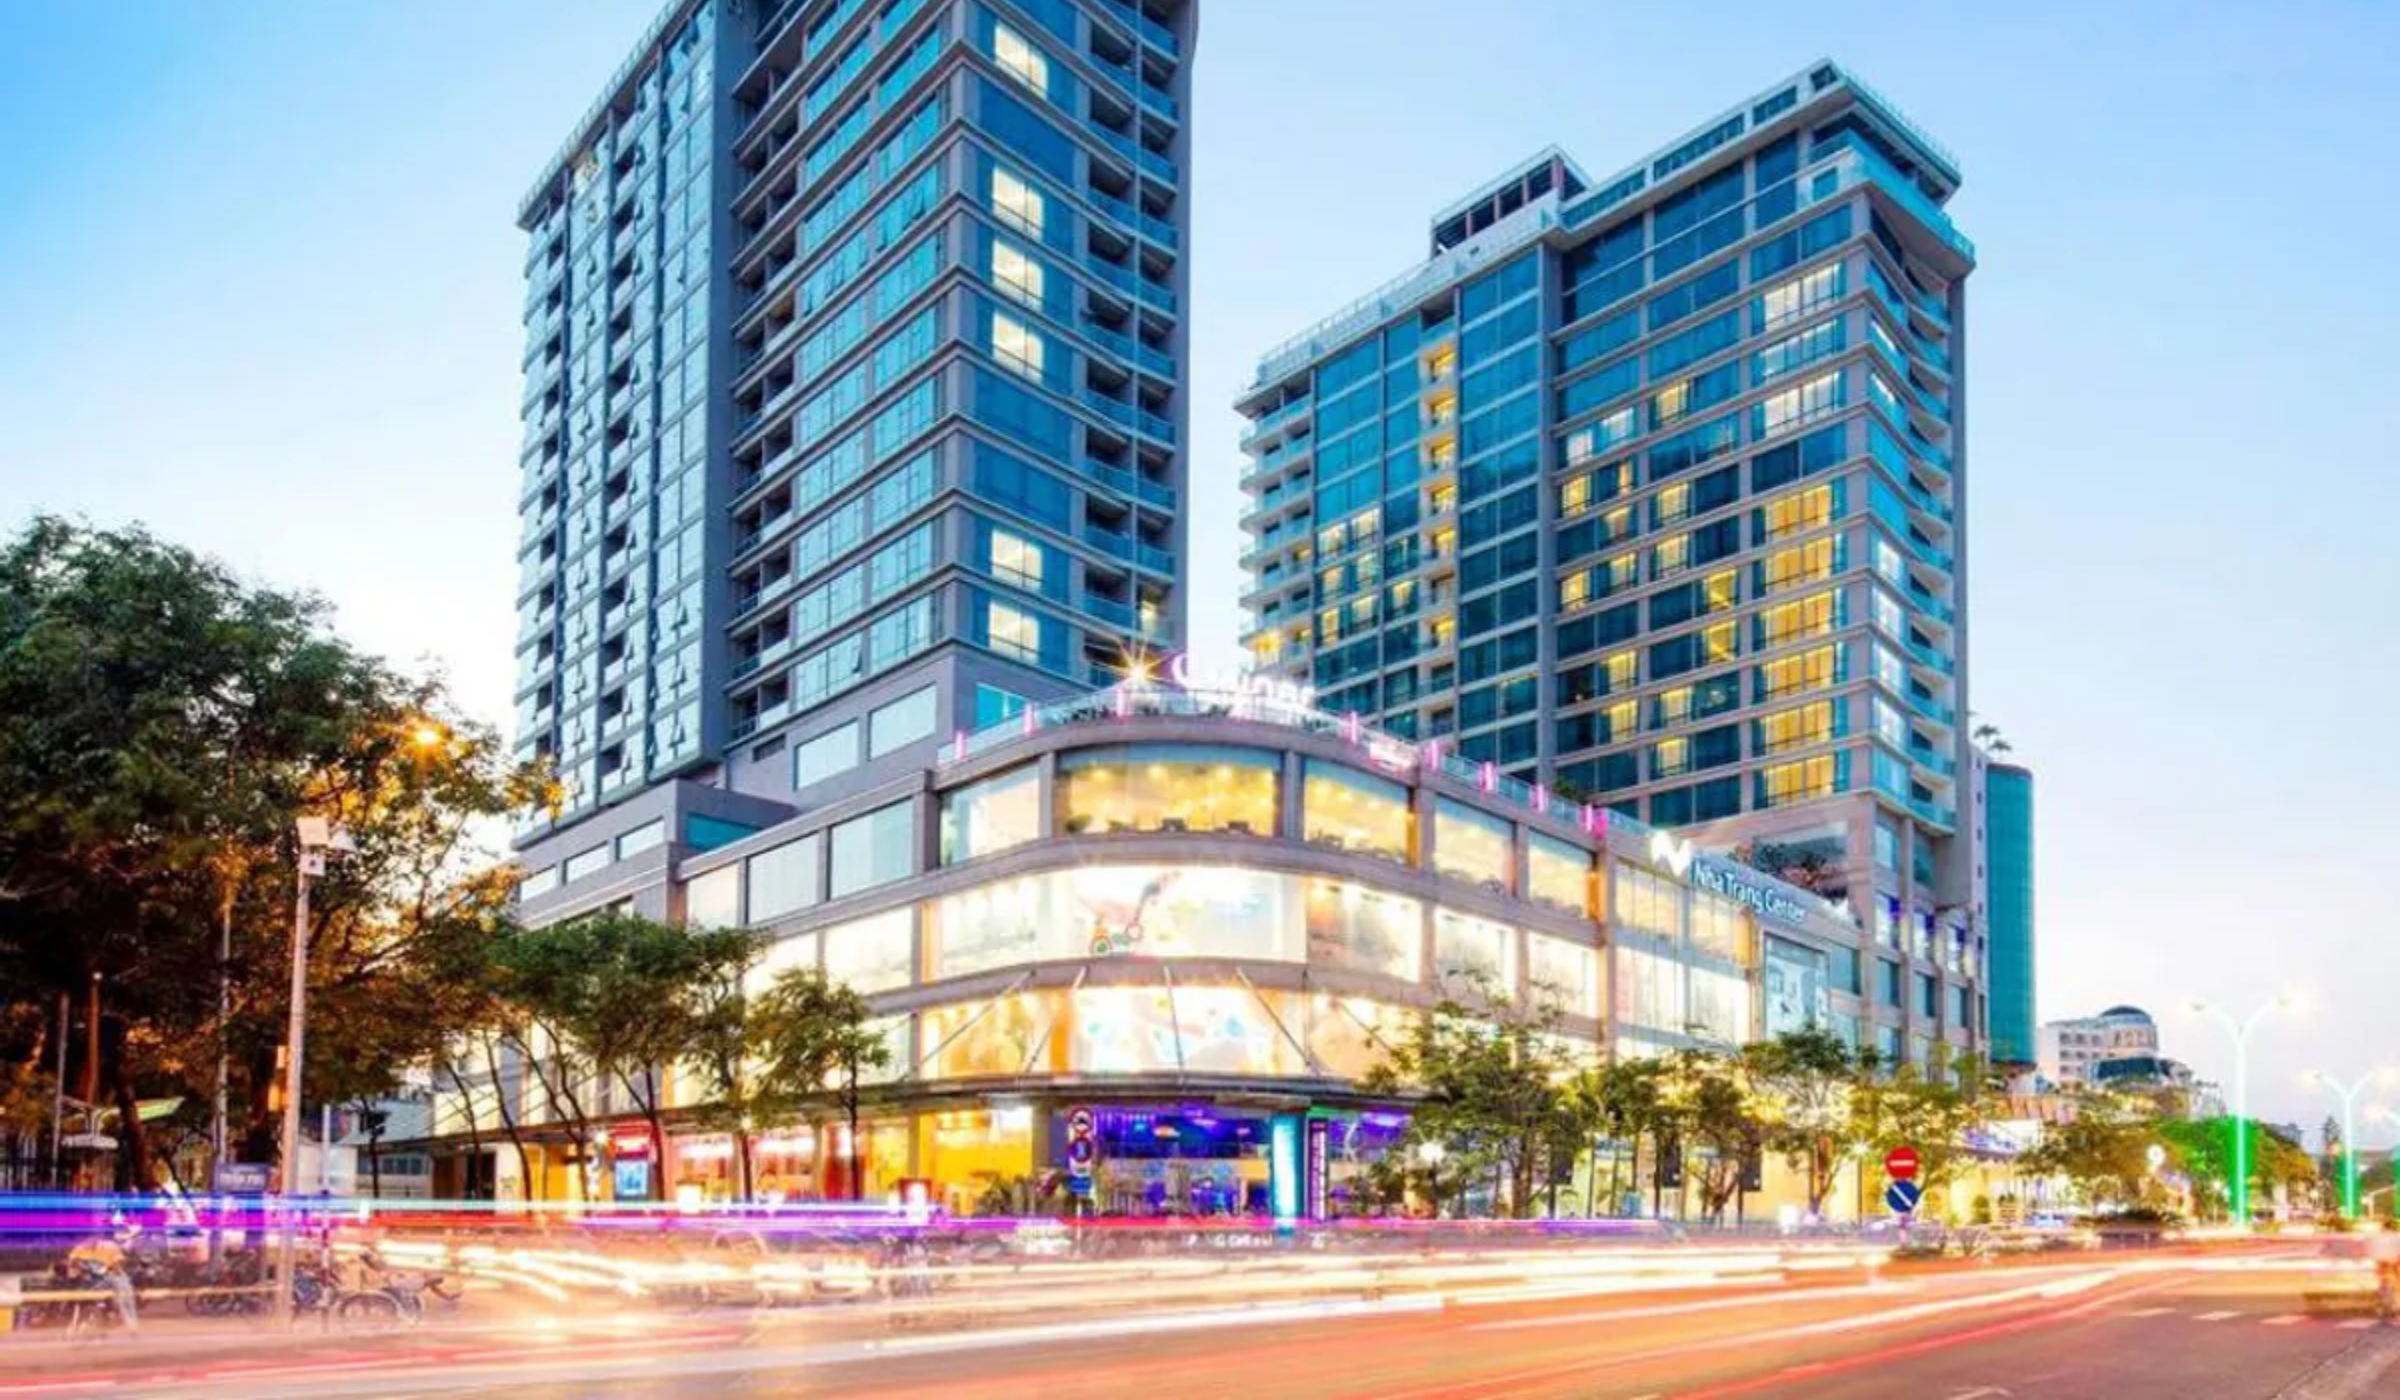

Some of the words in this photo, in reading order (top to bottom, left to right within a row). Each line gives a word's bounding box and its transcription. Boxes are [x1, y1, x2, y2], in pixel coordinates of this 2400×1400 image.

[1694, 859, 1724, 892] Nha
[1724, 872, 1764, 913] Trang
[1765, 888, 1807, 924] Center
